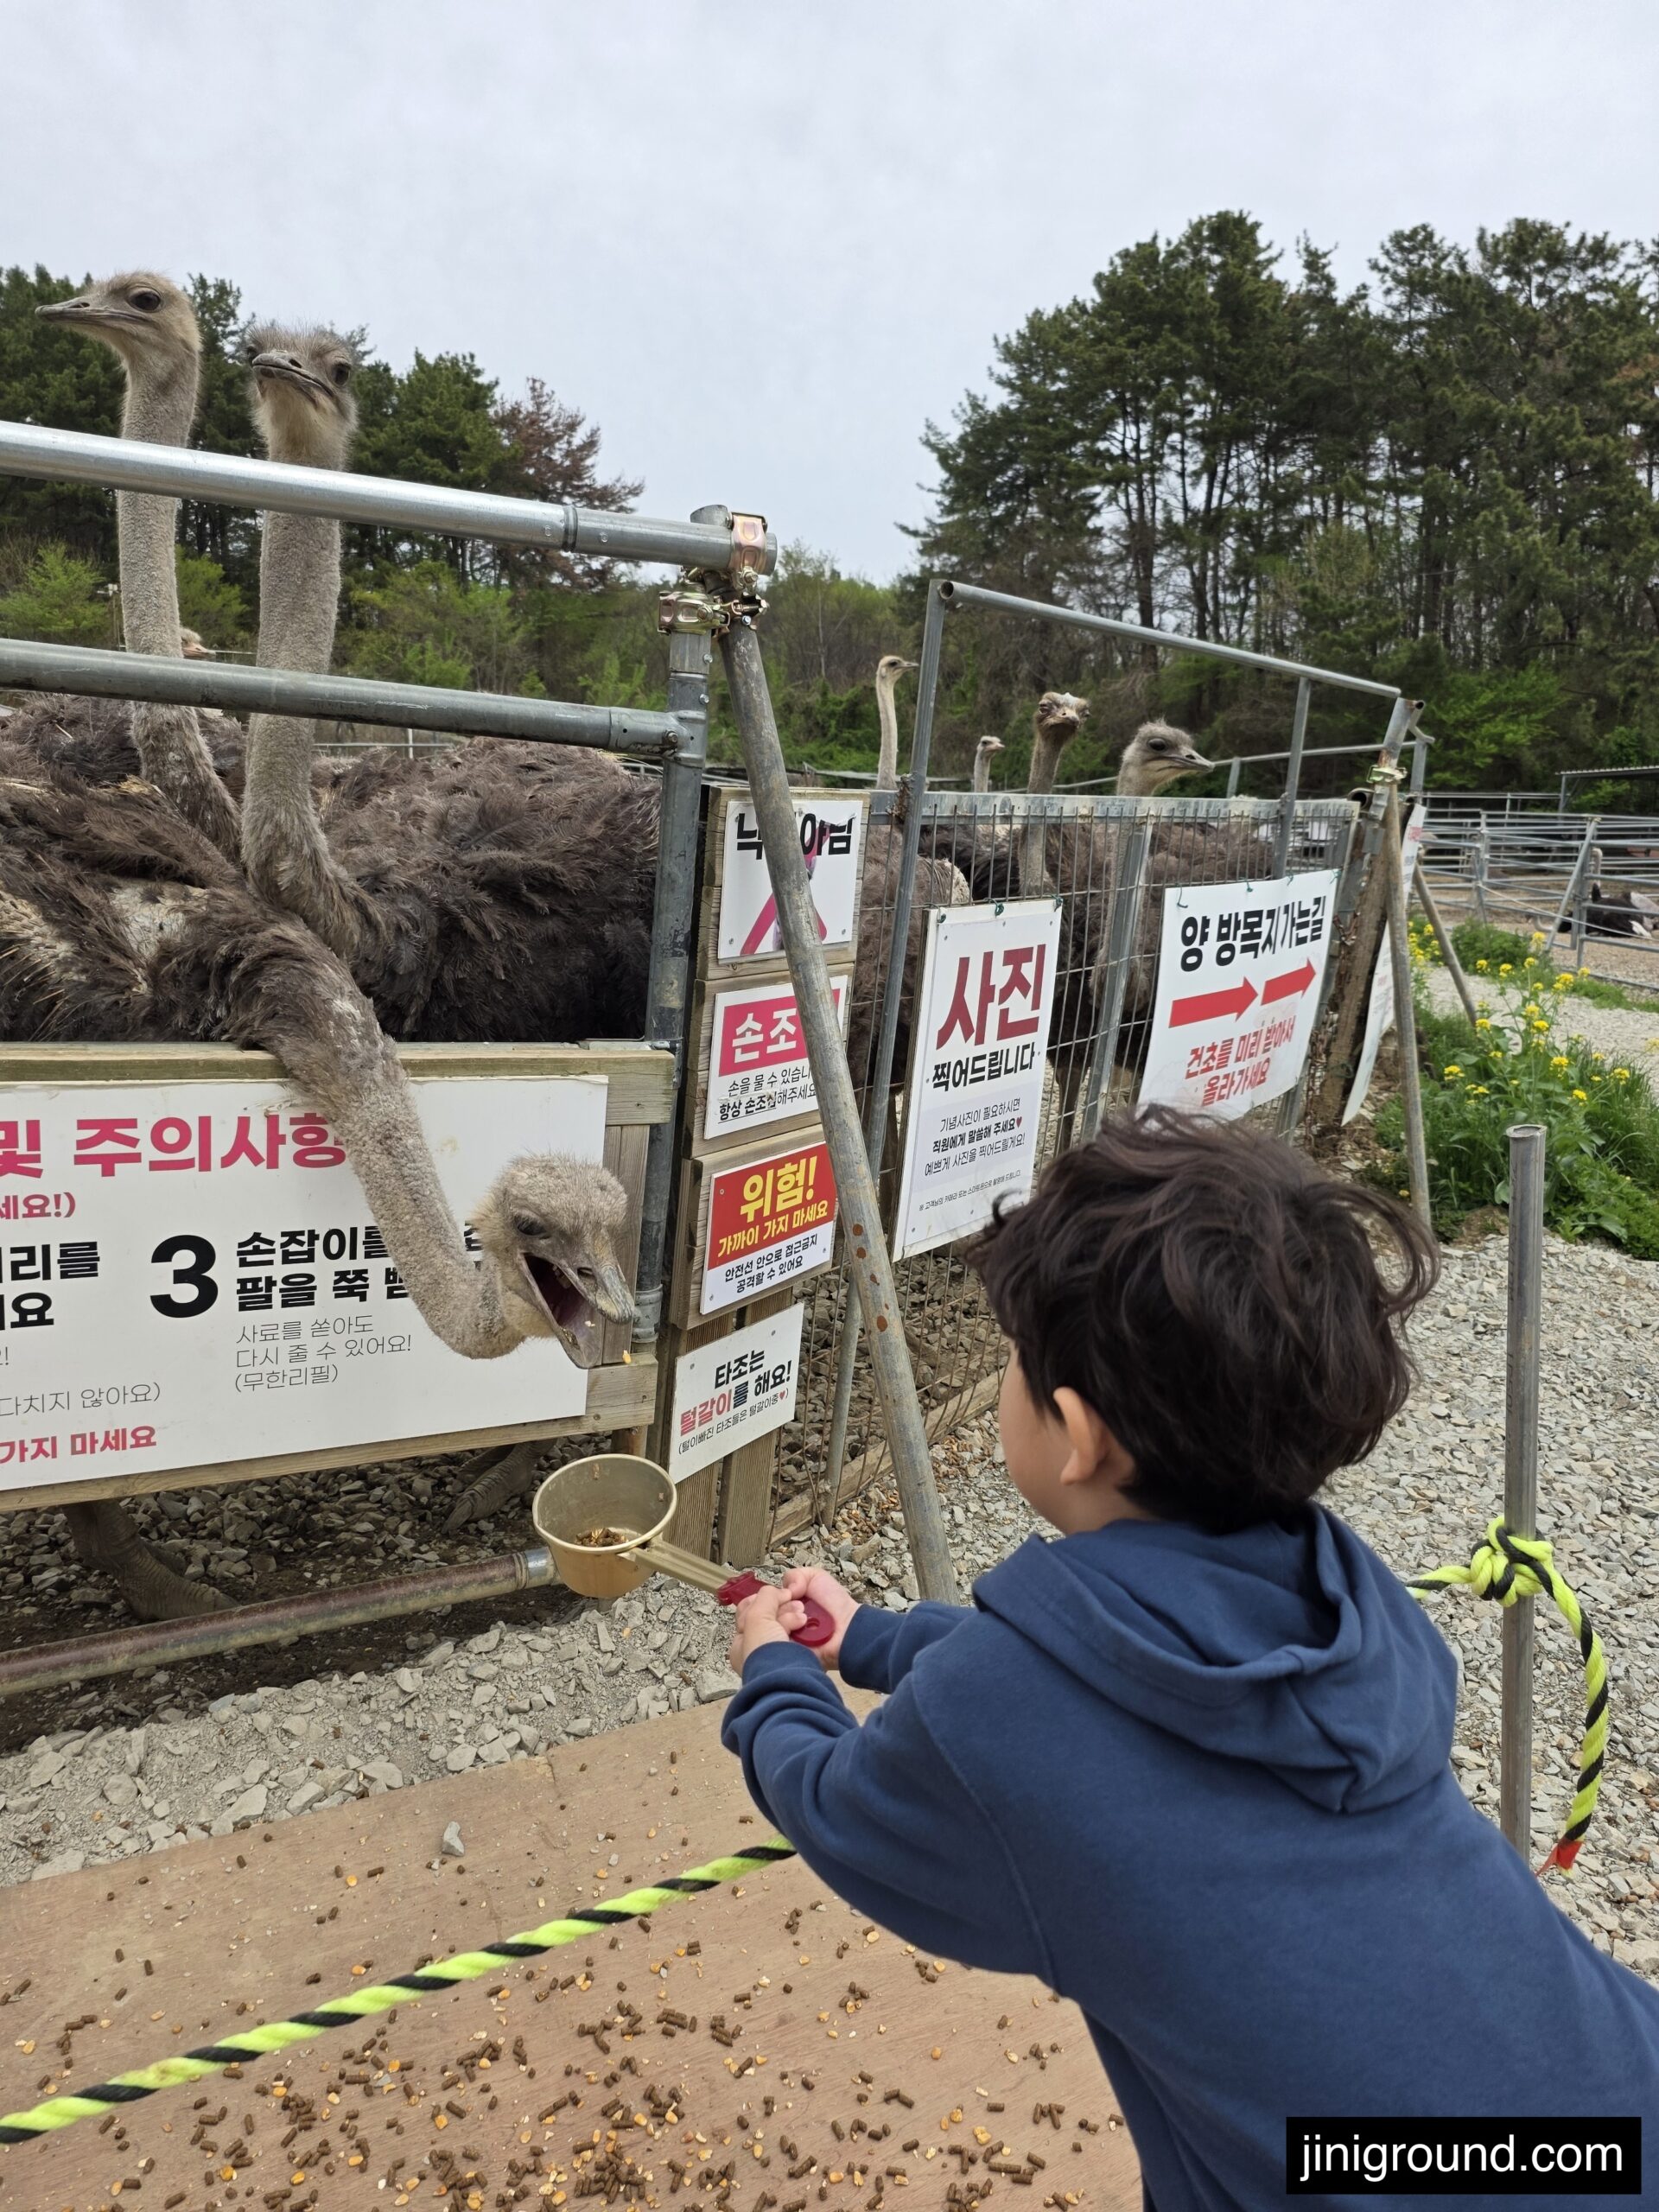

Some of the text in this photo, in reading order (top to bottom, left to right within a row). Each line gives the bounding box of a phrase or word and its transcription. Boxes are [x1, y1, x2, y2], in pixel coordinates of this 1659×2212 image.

[1180, 916, 1211, 973] 양
[936, 944, 1046, 1052] 사진
[732, 1007, 798, 1064] 손조
[1185, 1014, 1297, 1079] 건초를 미리 받아서
[728, 1065, 811, 1098] 손을 물 수 있습니
[931, 1042, 1036, 1092] 찍어드립니다
[1202, 1057, 1271, 1107] 올라가세요
[719, 1099, 742, 1122] 항상
[940, 1097, 1020, 1133] 기념사진이 필요하시면
[0, 1119, 43, 1179] 및
[925, 1133, 1026, 1177] 예쁘게 사진을 찍어드릴게요!
[932, 1117, 1015, 1154] 직원에게 말씀해 주세요
[740, 1155, 817, 1224] 위험!
[717, 1199, 829, 1258] 가까이 가지 마세요
[0, 1241, 100, 1284] 리를
[149, 1234, 219, 1319] 3
[724, 1233, 818, 1283] 안전선 안으로 접근금지
[736, 1255, 804, 1294] 공격할 수 있어요
[0, 1292, 54, 1332] 요
[236, 1272, 318, 1313] 팔을
[332, 1268, 370, 1303] 쭉
[236, 1314, 374, 1344] 사료를 쏟아도
[236, 1334, 411, 1368] 다시 줄 수 있어요!
[235, 1363, 338, 1393] (무한리필)
[715, 1350, 765, 1389] 타조는
[80, 1382, 161, 1408] 않아요)
[680, 1360, 792, 1437] 털갈이를 해요!
[70, 1425, 156, 1456] 마세요
[678, 1426, 715, 1455] (털이빠진
[715, 1409, 747, 1434] 타조들은
